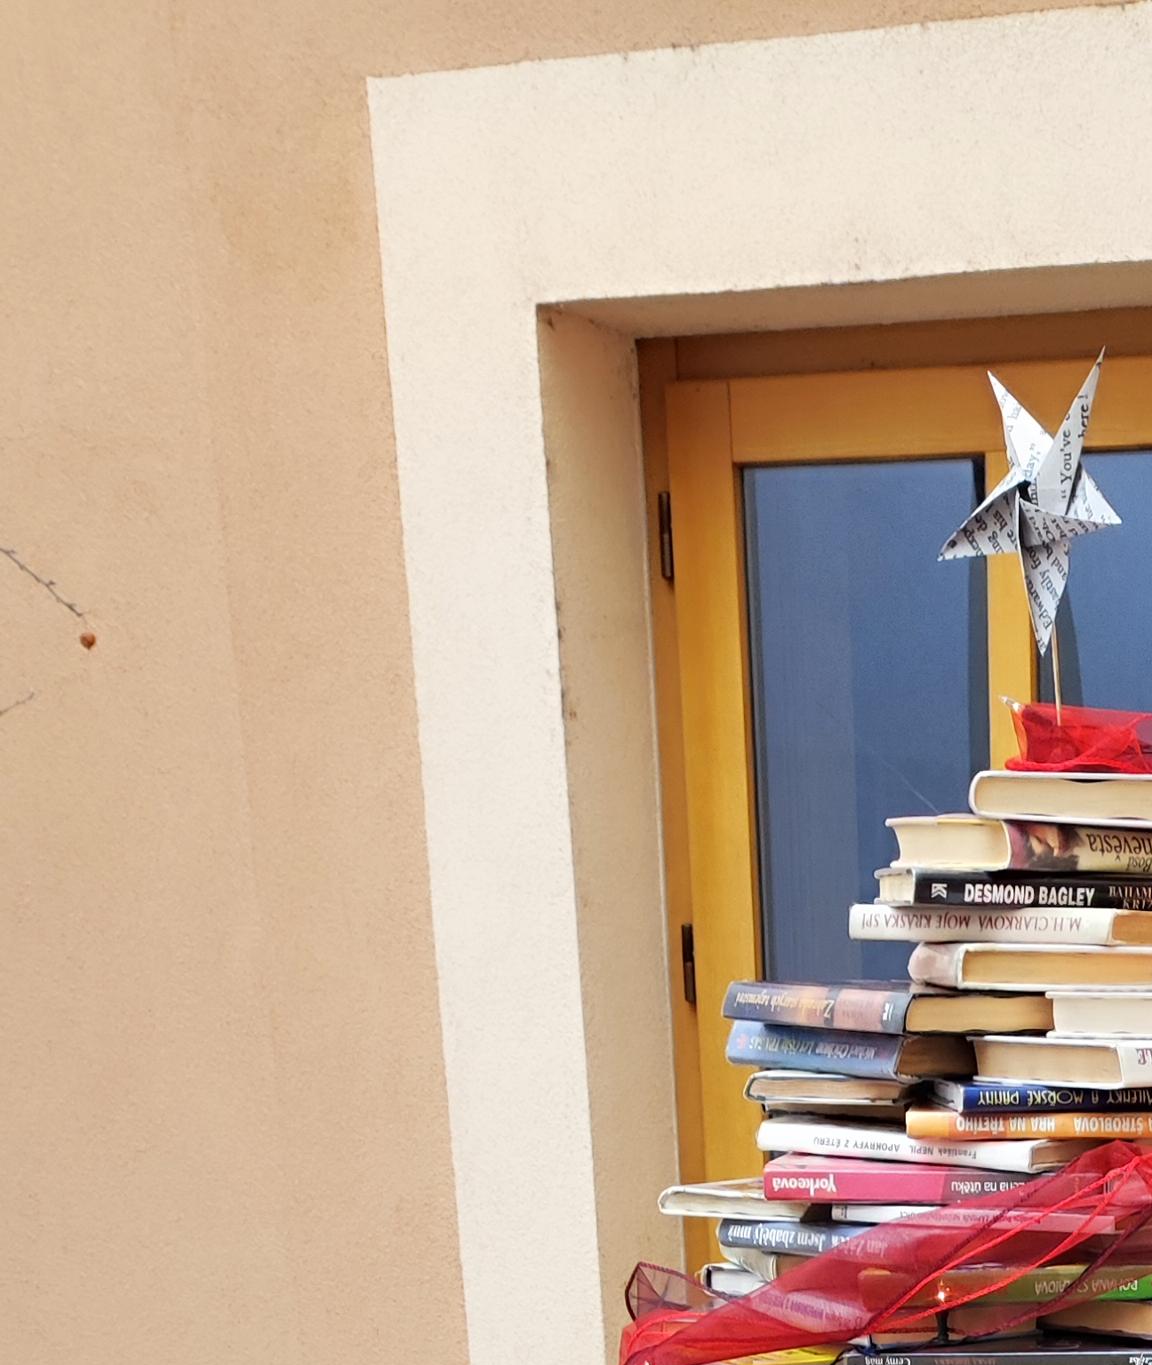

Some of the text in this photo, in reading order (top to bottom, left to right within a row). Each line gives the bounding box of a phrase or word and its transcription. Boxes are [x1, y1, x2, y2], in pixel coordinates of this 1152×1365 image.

[963, 885, 1096, 908] DESMOND BAGLEY
[883, 913, 935, 933] KRÁSKA
[937, 915, 970, 931] MOJE
[976, 1088, 1015, 1106] PANNY
[1019, 1092, 1083, 1109] MOŘSKÉ
[955, 1115, 1005, 1136] TŘETÍHO
[1009, 1115, 1025, 1134] NA
[1030, 1115, 1055, 1134] HRA
[1073, 1115, 1145, 1135] ŠTROBLOVÁ
[853, 1138, 900, 1154] APOKRYFY
[772, 1173, 837, 1194] Yorkeová
[951, 1179, 983, 1196] útěku
[798, 1229, 825, 1249] Jsem
